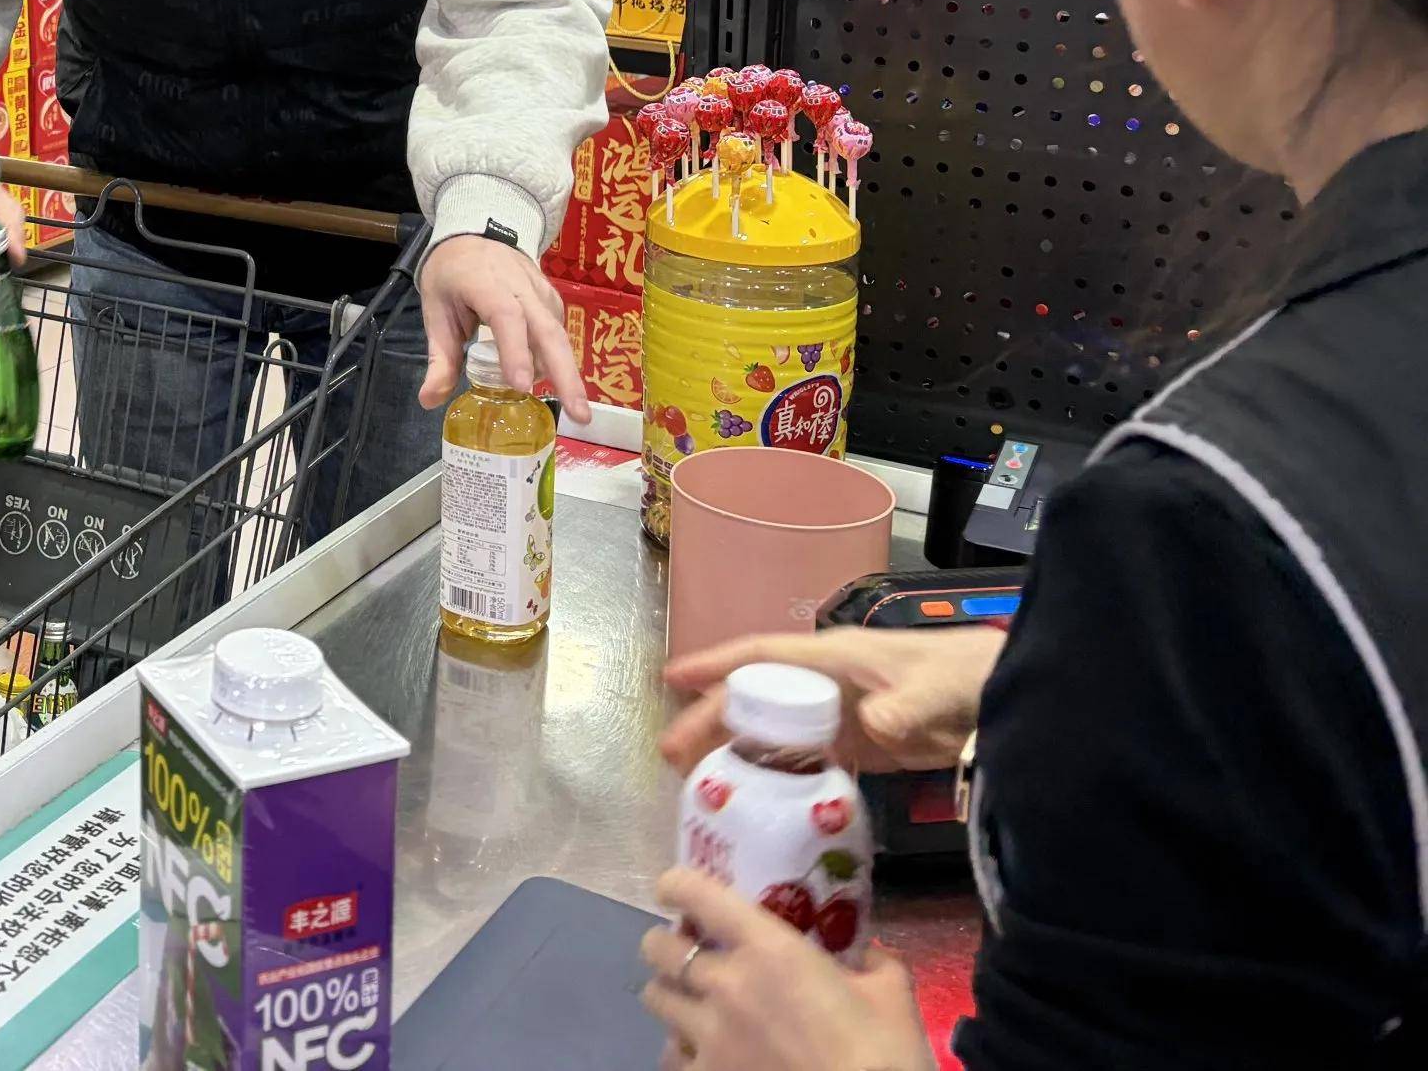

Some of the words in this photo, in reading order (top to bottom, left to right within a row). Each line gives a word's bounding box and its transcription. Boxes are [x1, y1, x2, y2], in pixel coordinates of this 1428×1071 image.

[585, 309, 643, 406] 鸿运
[774, 386, 837, 445] 真知棒
[5, 494, 31, 512] YES
[47, 506, 68, 521] NO
[84, 515, 104, 530] NO
[145, 742, 214, 865] 100%
[289, 897, 352, 934] 丰之源
[254, 972, 359, 1033] 100%
[261, 1007, 378, 1071] NFC
